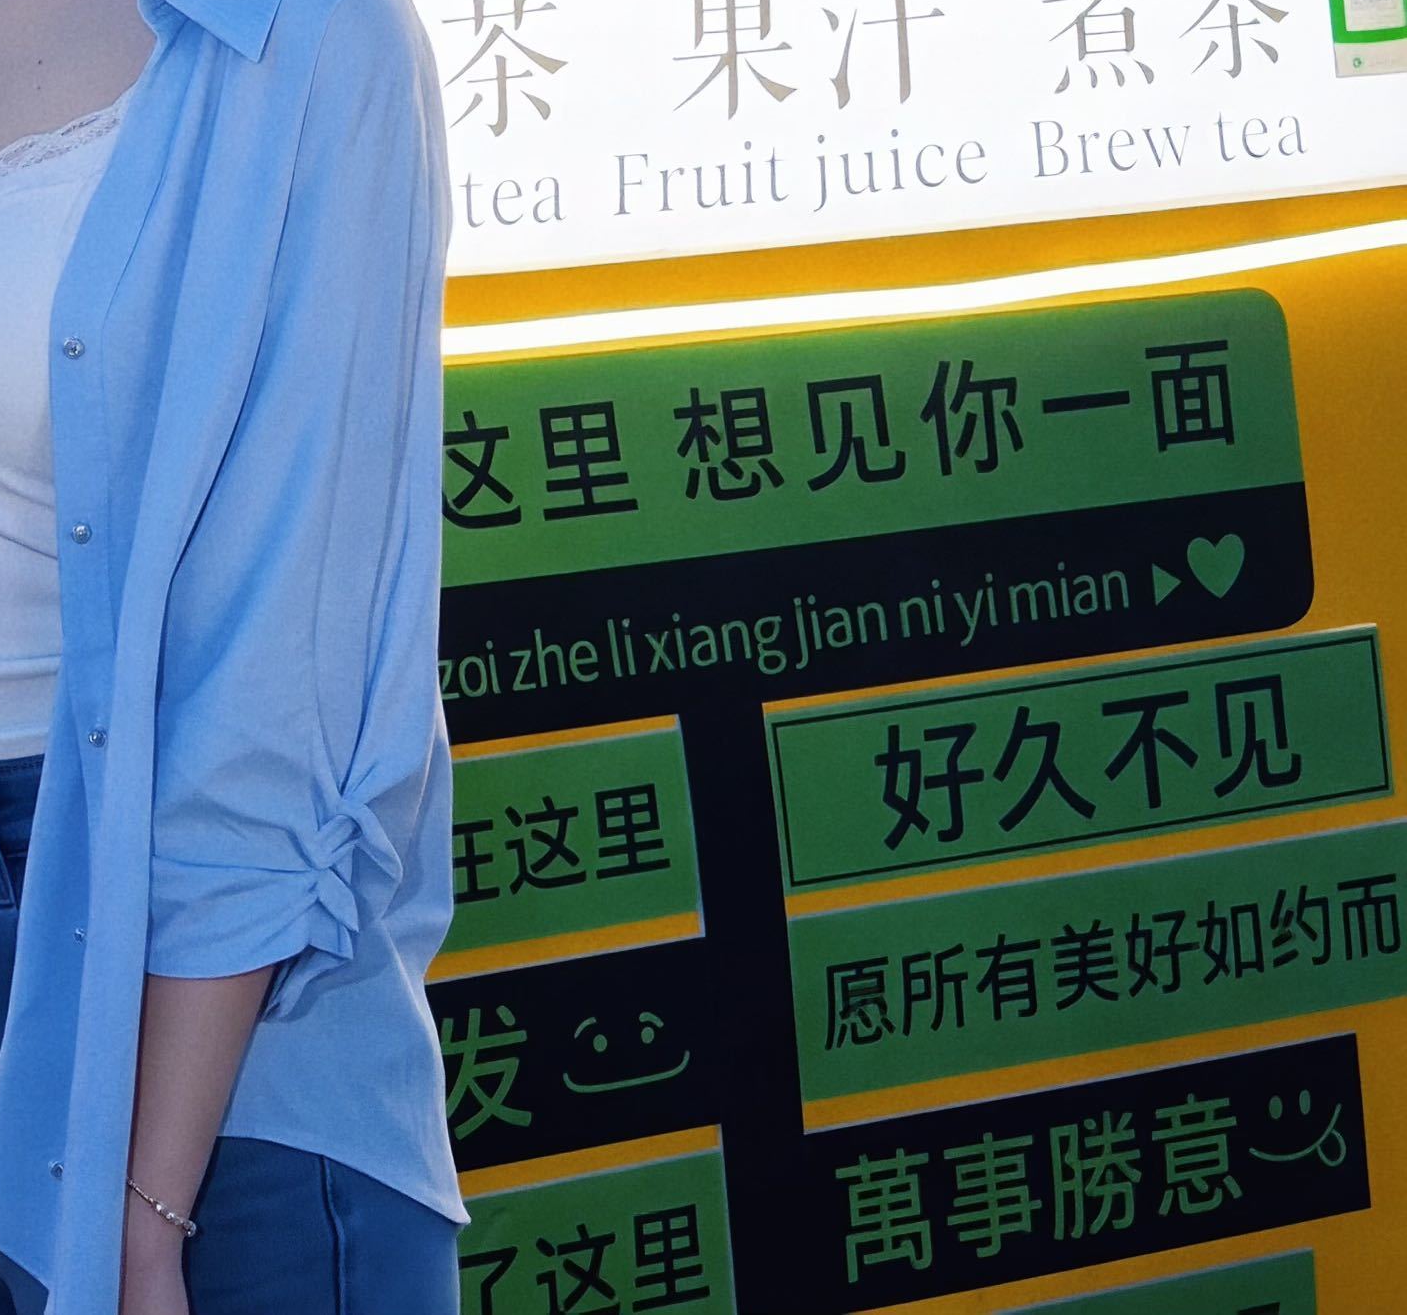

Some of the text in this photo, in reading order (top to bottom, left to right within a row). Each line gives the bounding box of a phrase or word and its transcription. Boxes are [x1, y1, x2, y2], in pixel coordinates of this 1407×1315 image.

[459, 110, 1309, 228] tea Fruit juice Brew tea
[672, 338, 1237, 501] 想见你一面
[509, 628, 600, 692] zhe
[607, 618, 637, 678] li
[644, 612, 788, 675] xiang
[793, 594, 889, 670] jian
[899, 578, 946, 638] ni
[953, 572, 998, 648] yi
[1008, 561, 1130, 625] mian
[874, 675, 1303, 851] 好久不见
[823, 872, 1402, 1053] 愿所有美好如约而
[834, 1093, 1244, 1285] 萬事勝意
